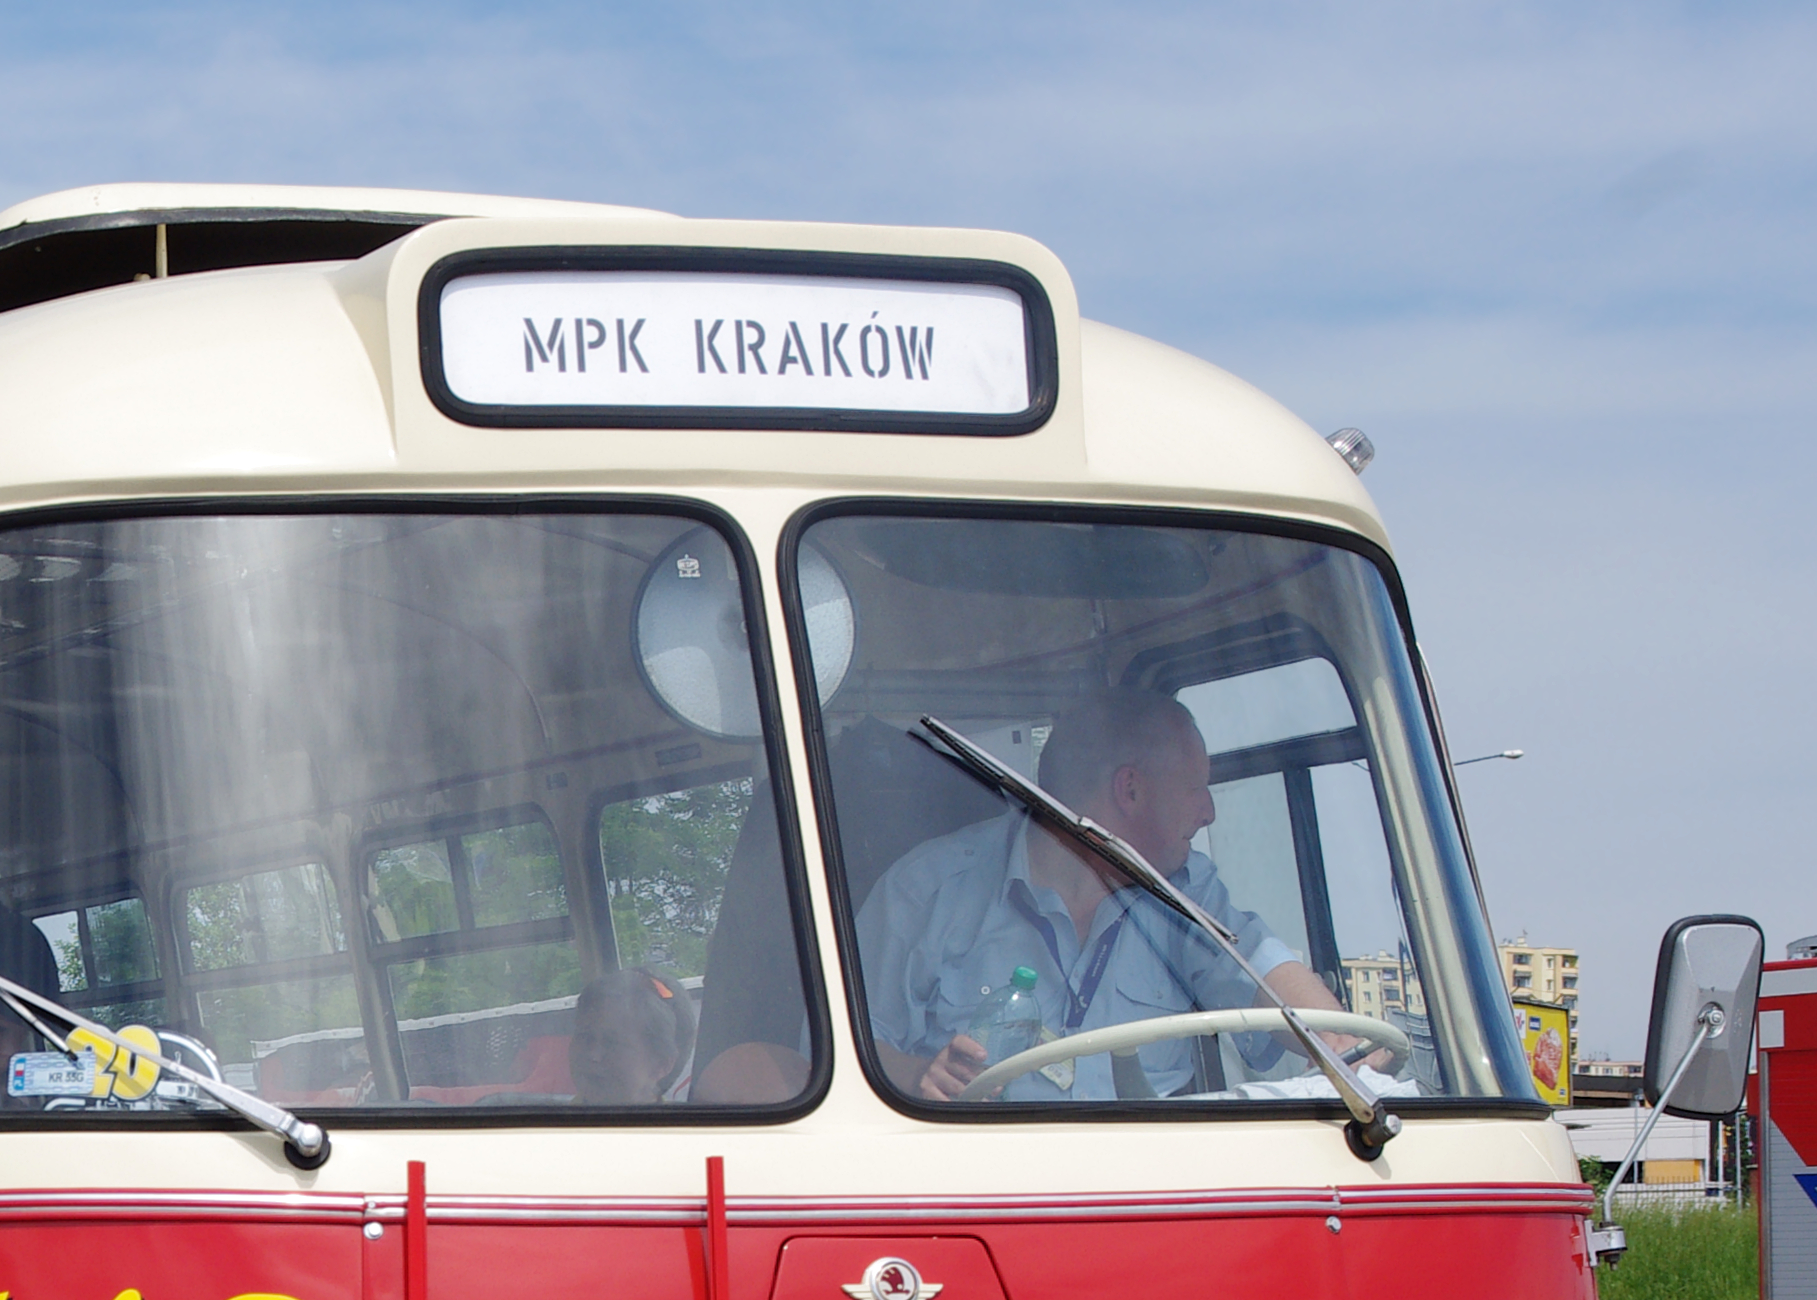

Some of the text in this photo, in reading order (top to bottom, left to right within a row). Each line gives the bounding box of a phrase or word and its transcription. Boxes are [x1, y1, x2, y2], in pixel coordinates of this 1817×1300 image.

[521, 310, 936, 381] MPK KRAKÓW
[48, 1072, 63, 1083] KR
